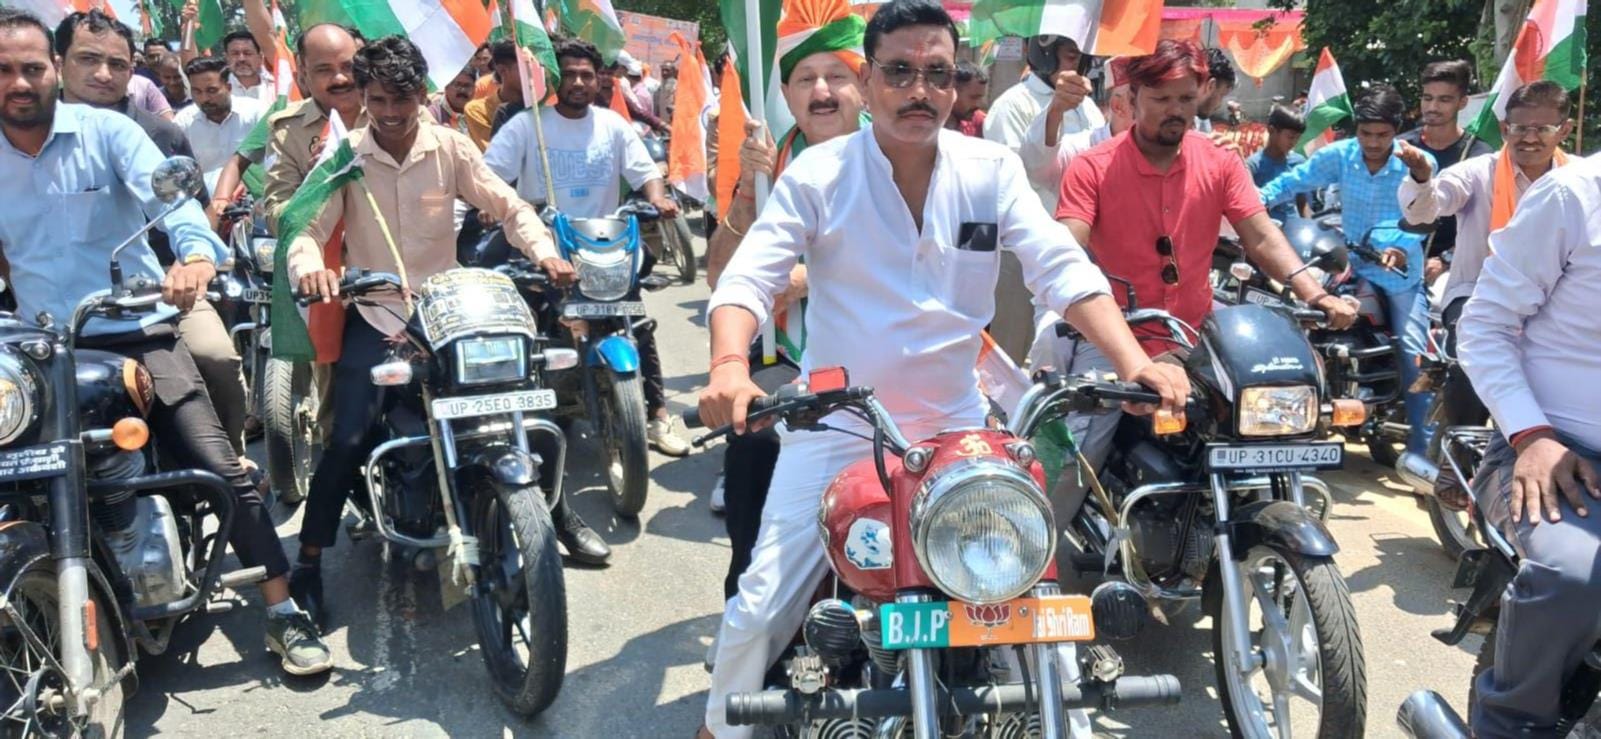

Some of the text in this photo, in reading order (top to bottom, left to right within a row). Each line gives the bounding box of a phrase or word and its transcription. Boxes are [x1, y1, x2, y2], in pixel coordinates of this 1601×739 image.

[450, 402, 468, 415] UP
[517, 394, 553, 409] 3835
[1229, 447, 1338, 464] UP 31CU 4340
